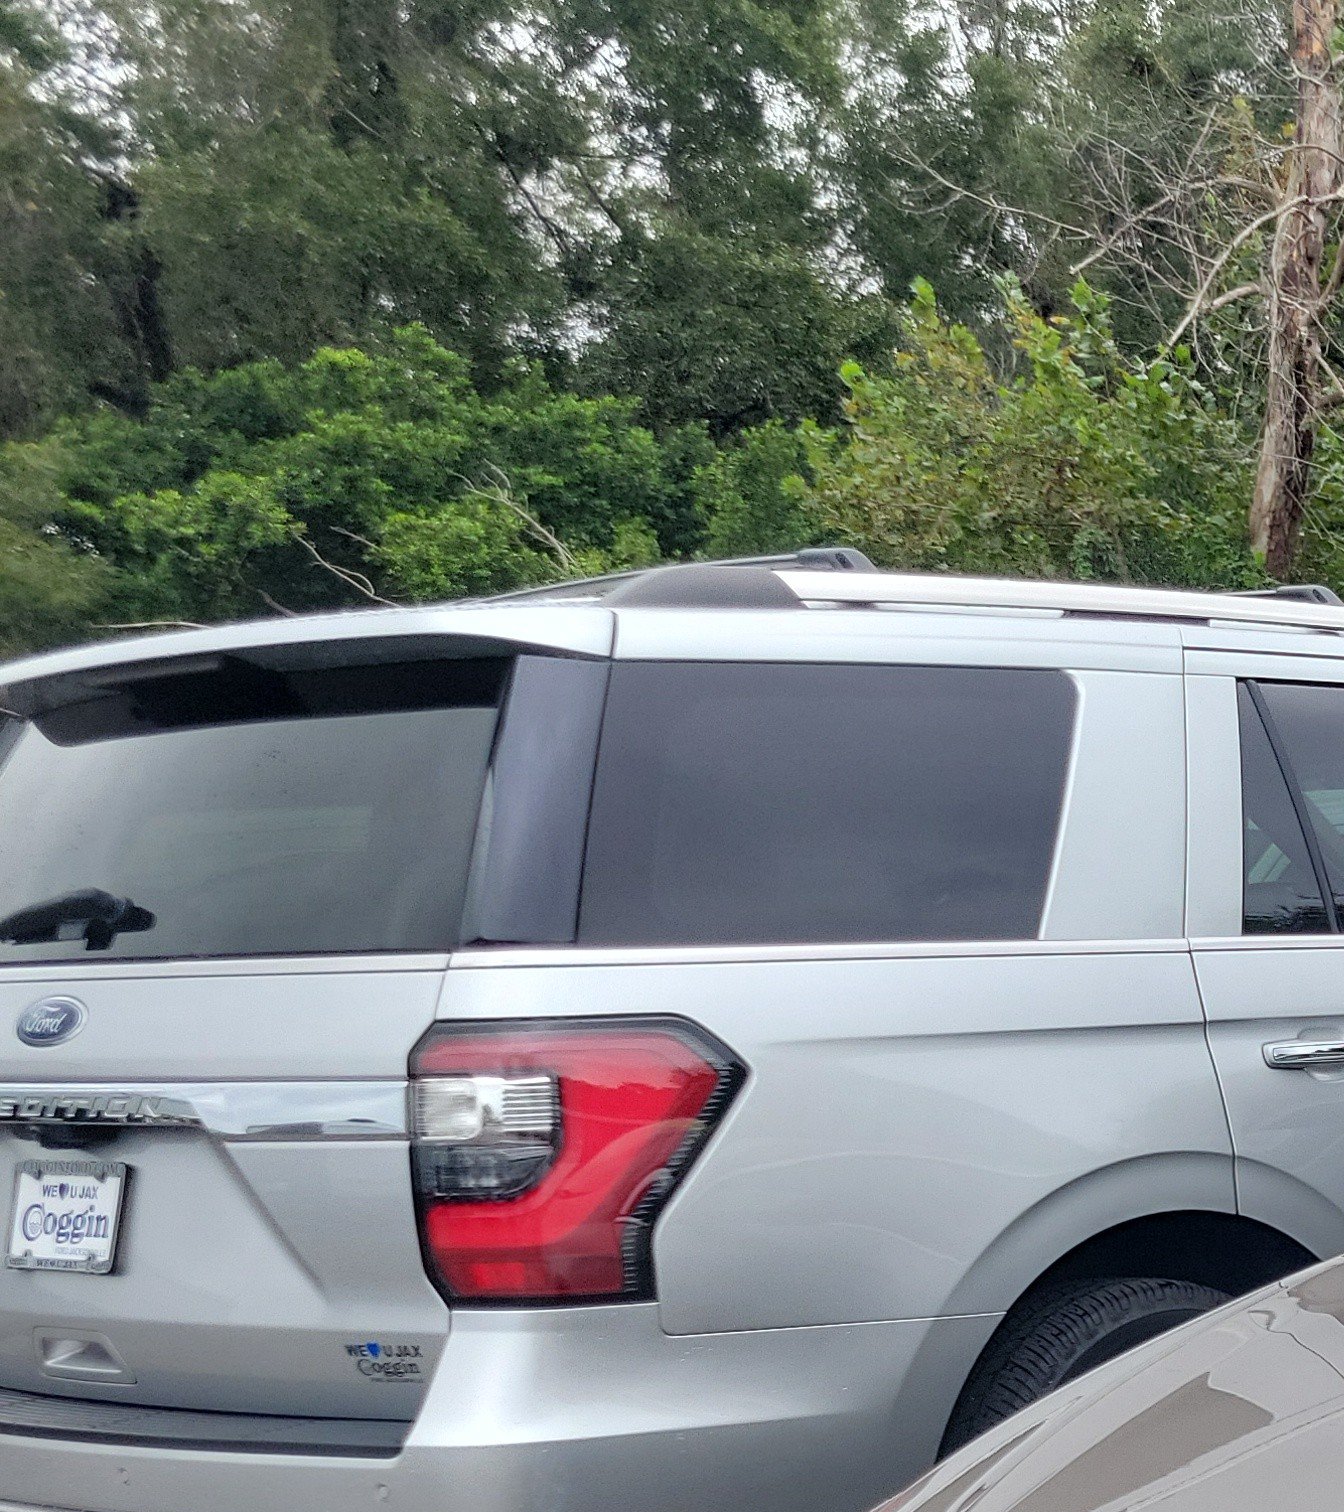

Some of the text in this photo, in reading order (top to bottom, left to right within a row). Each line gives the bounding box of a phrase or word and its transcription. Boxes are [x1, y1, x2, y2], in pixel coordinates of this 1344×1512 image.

[24, 1004, 68, 1034] Ford
[42, 1184, 58, 1198] WE
[79, 1185, 100, 1200] JAX
[22, 1202, 109, 1245] Coggin
[344, 1345, 368, 1357] WE
[395, 1345, 423, 1358] JAX
[357, 1359, 421, 1377] Coggin
